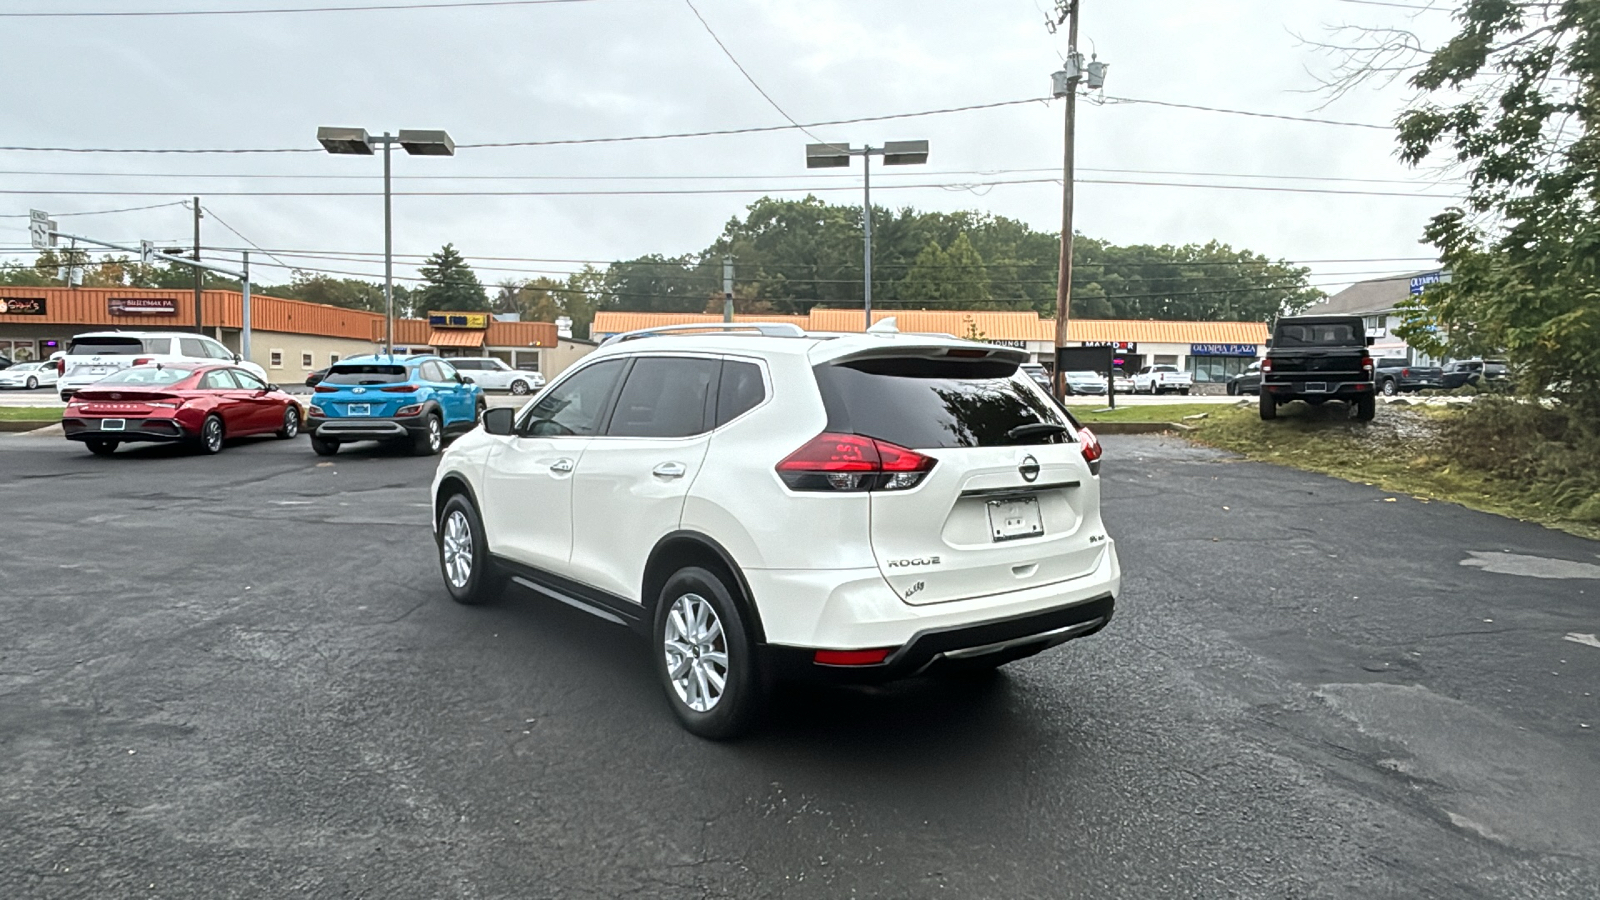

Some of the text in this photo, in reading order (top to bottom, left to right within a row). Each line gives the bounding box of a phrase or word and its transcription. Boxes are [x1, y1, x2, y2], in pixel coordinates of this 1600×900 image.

[32, 211, 46, 221] END
[1192, 344, 1228, 352] OLYMPIA
[1230, 344, 1256, 353] PLAZA
[886, 556, 941, 568] ROGUE
